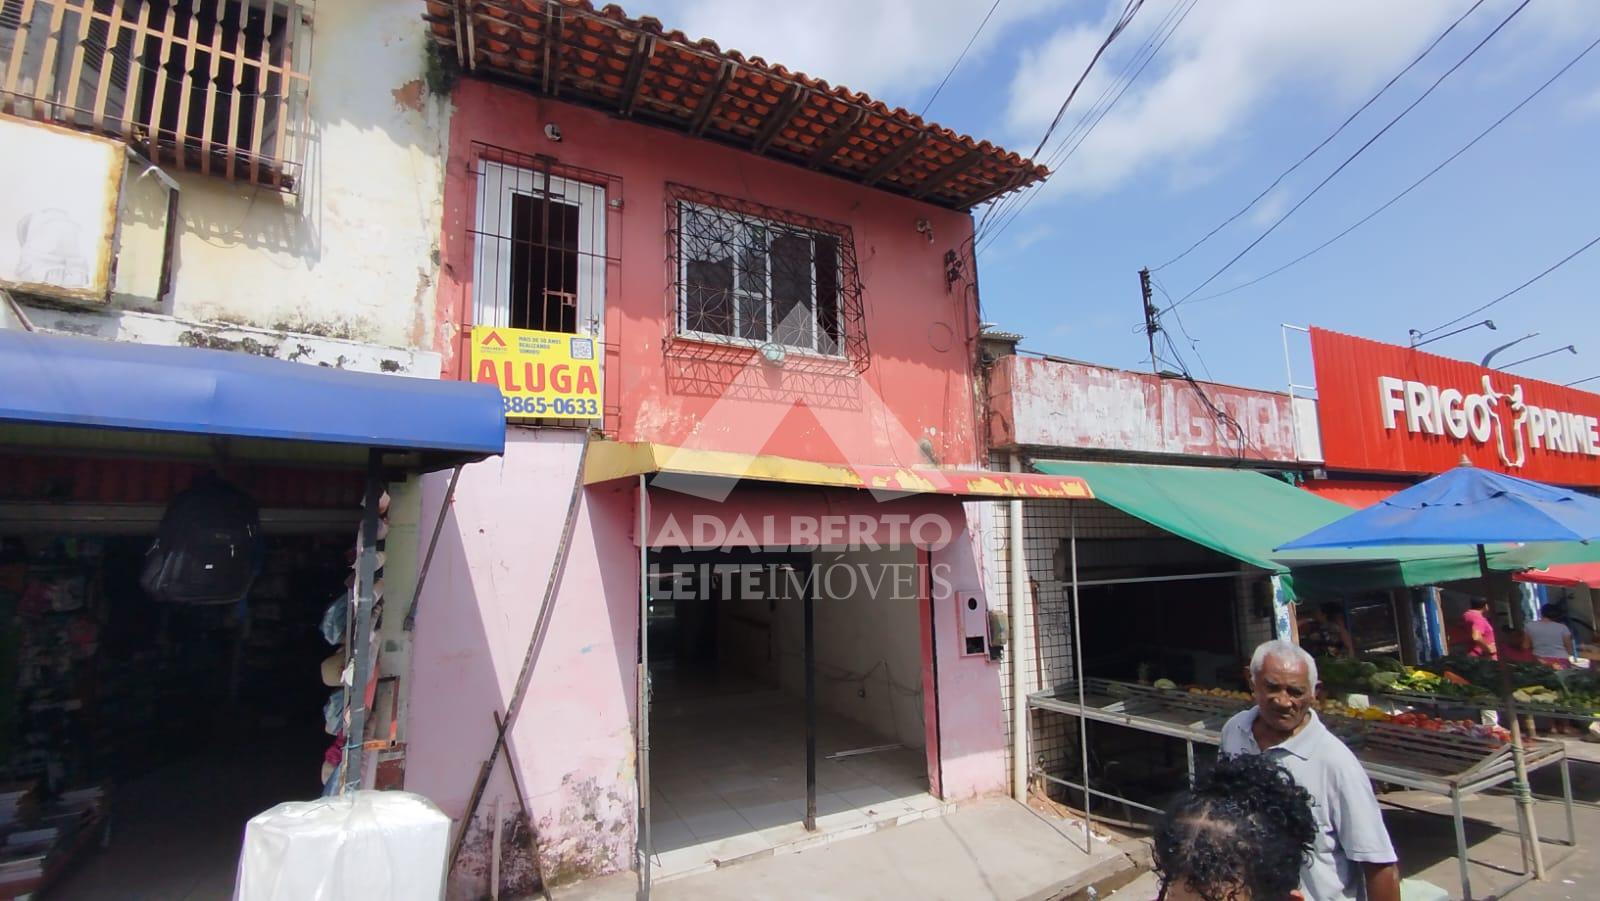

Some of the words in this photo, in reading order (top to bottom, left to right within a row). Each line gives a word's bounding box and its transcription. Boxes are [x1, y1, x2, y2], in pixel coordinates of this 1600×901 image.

[477, 359, 597, 394] ALUGA
[1378, 376, 1490, 442] FRIGO
[1525, 404, 1600, 455] PRIME
